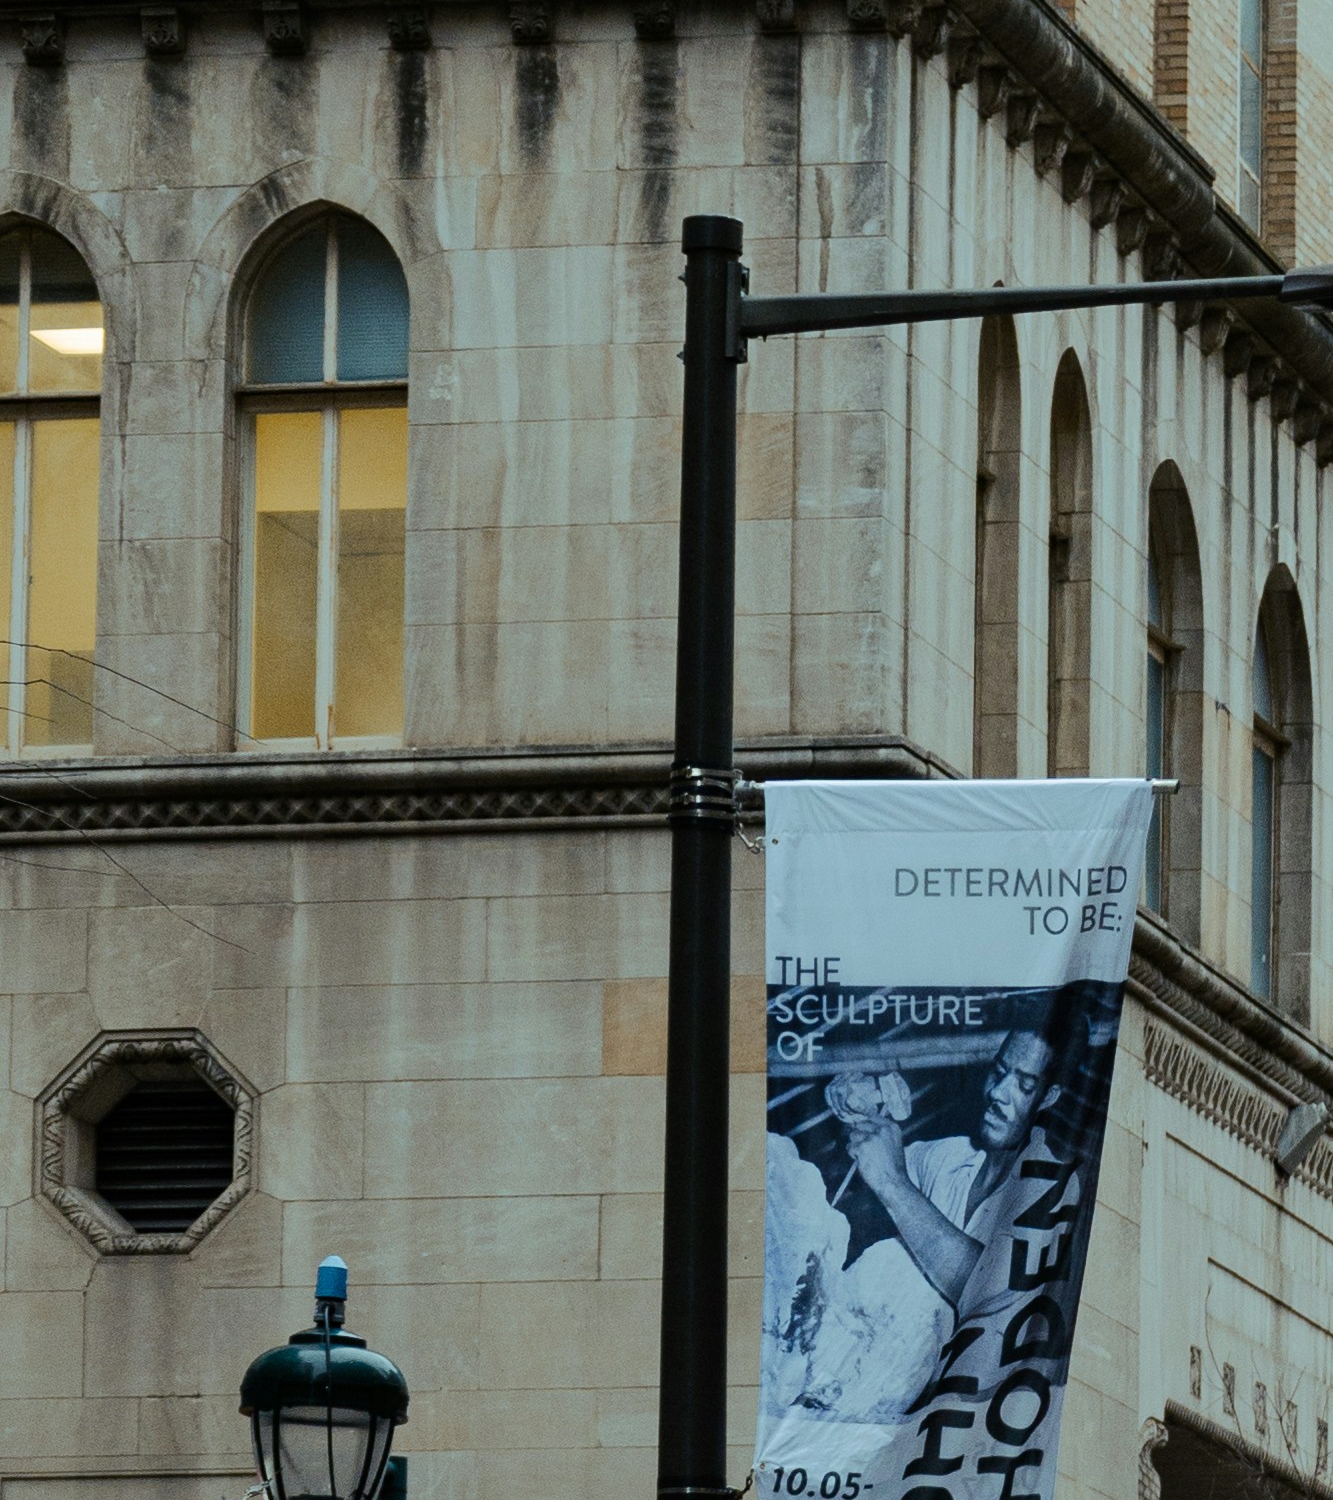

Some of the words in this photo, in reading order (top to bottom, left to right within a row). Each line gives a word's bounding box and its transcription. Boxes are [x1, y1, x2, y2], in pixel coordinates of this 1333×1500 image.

[894, 865, 1127, 898] DETERMINED
[1023, 905, 1069, 936] TO
[1080, 902, 1122, 934] BE:
[775, 956, 841, 987] THE
[775, 994, 983, 1026] SCULPTURE
[776, 1031, 824, 1062] OF
[771, 1467, 874, 1500] 10.05-
